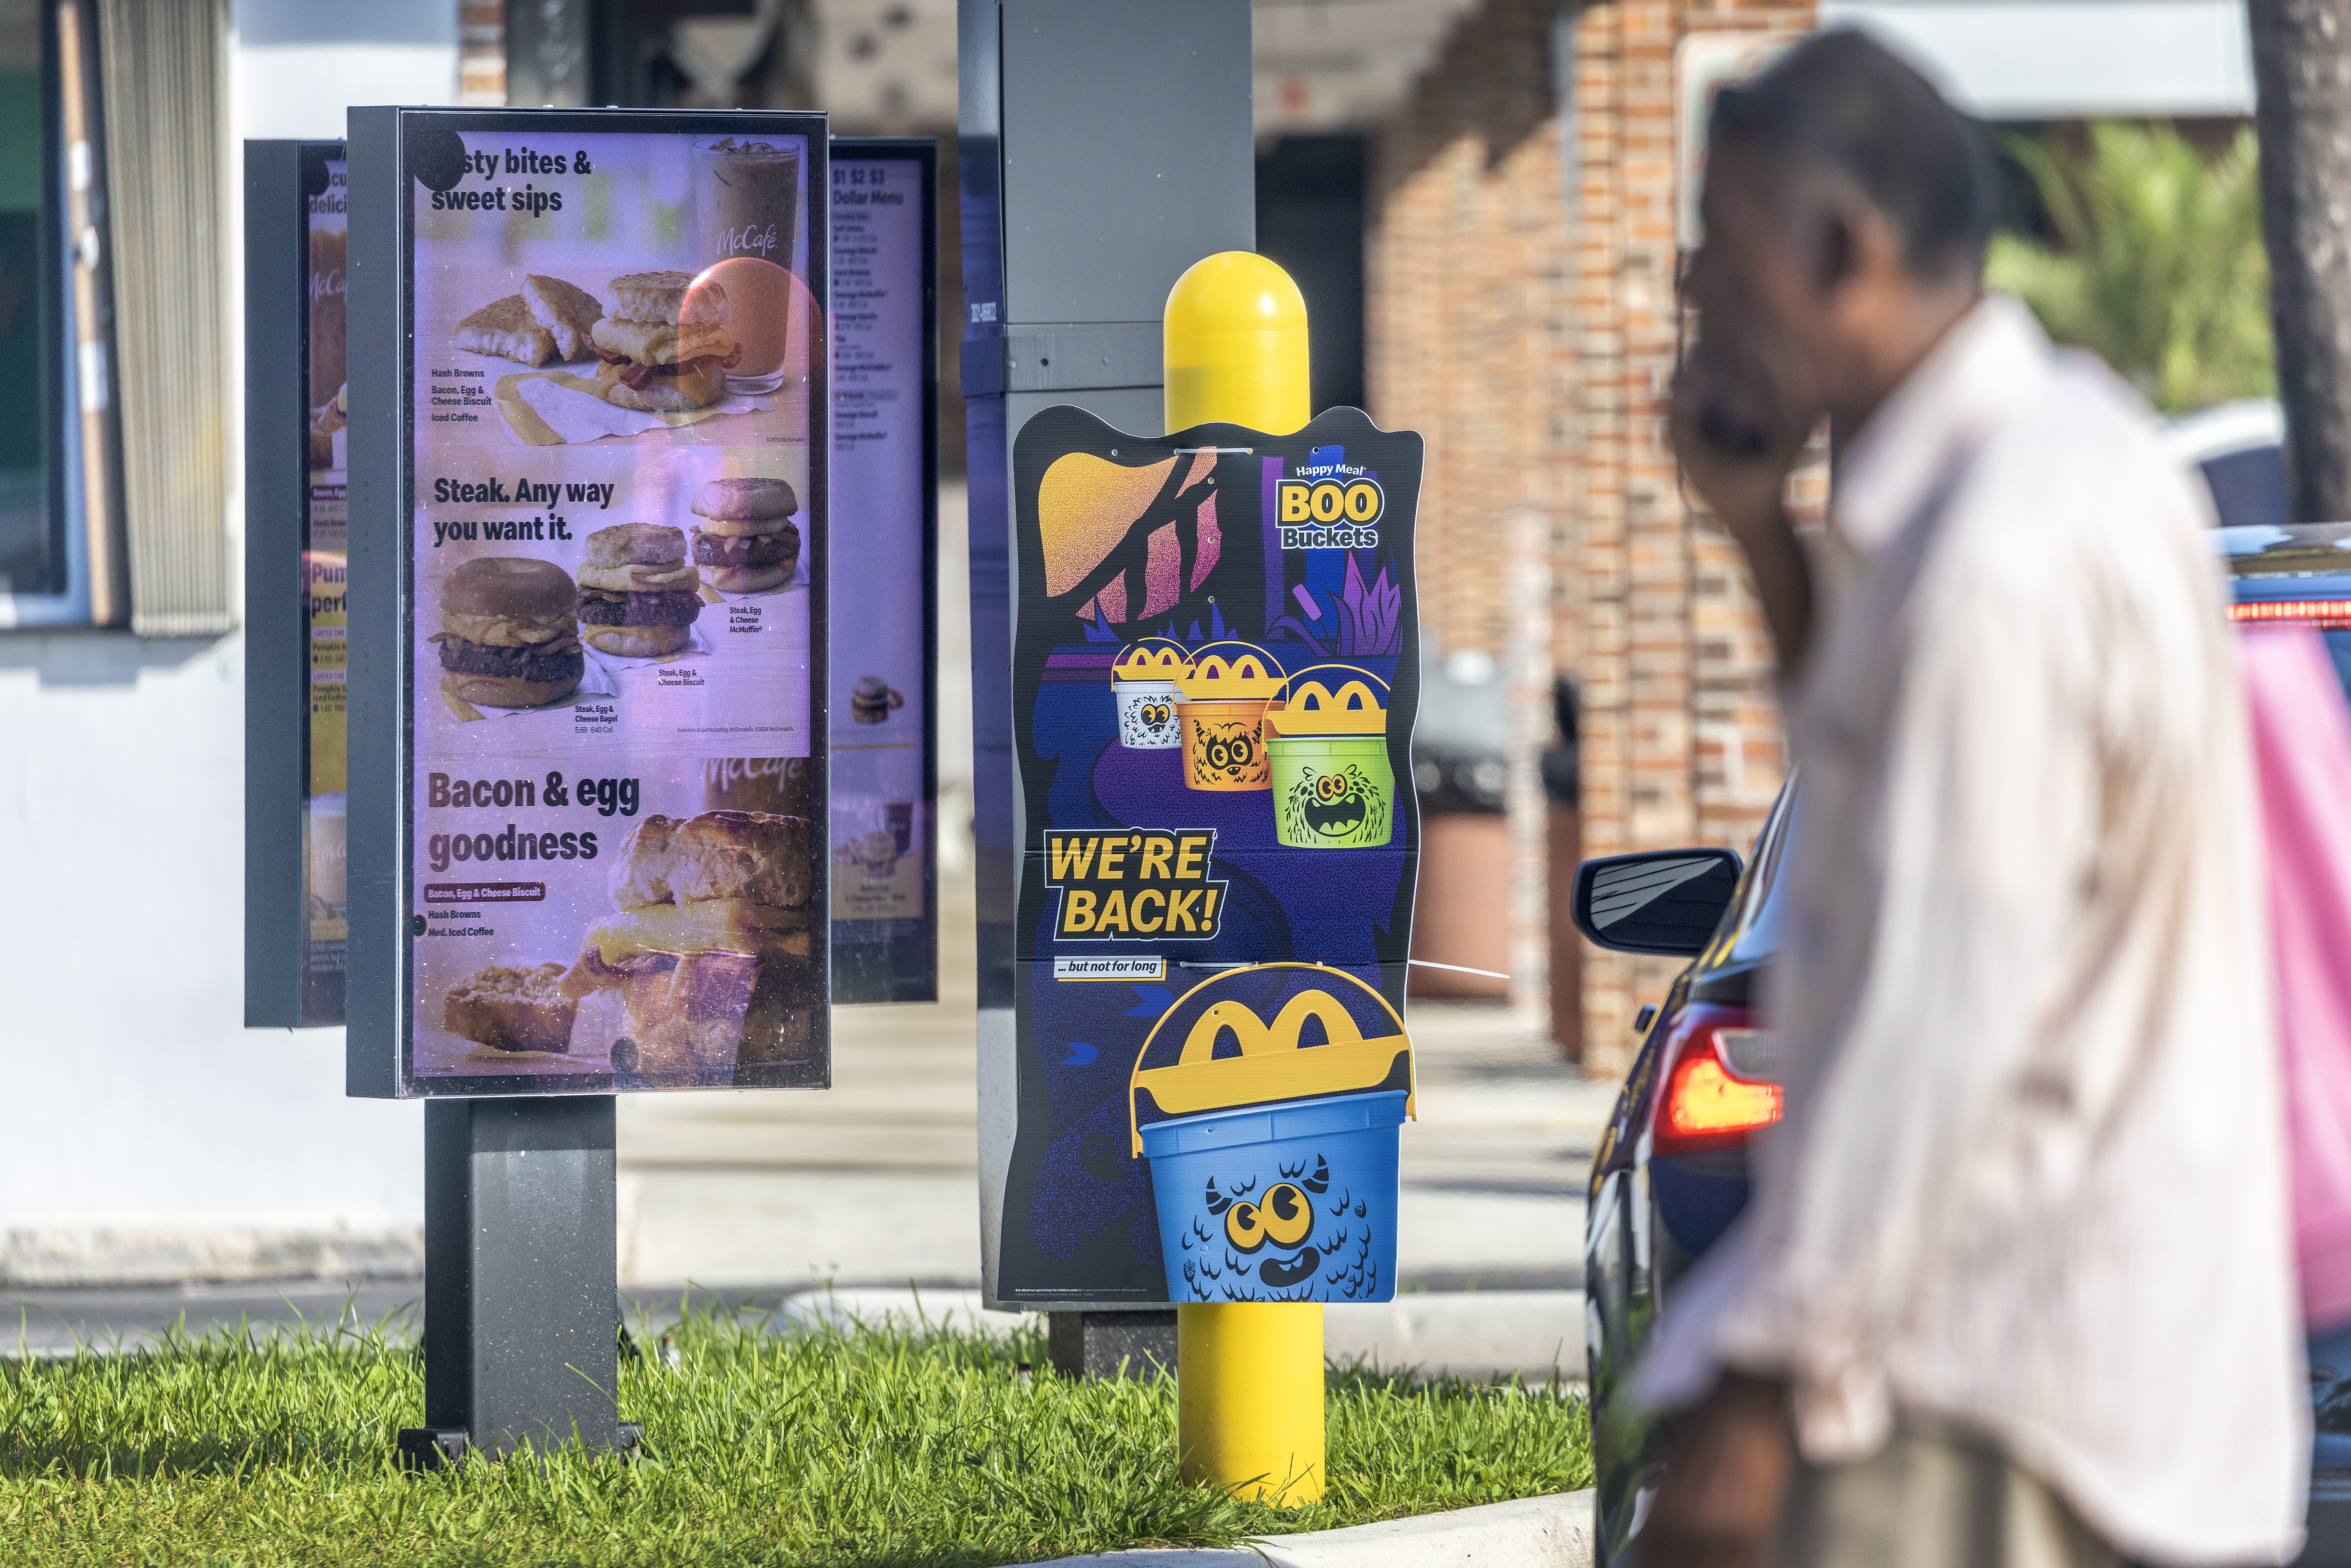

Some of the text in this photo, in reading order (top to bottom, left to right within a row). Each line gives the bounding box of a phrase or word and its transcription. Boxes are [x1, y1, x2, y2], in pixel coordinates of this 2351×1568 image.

[463, 146, 592, 181] sty bites &
[850, 168, 865, 184] $2
[870, 168, 885, 184] $3
[309, 194, 347, 213] delici
[432, 183, 562, 218] sweet sips
[833, 190, 904, 205] Dollar Menu
[717, 224, 776, 257] McCafé
[461, 386, 476, 396] Egg
[478, 386, 484, 394] &
[464, 396, 492, 405] Biscuit
[432, 413, 478, 421] Iced Coffee
[1296, 465, 1334, 477] Happy
[434, 477, 615, 510] Steak. Any way
[1282, 484, 1379, 522] BOO
[434, 513, 572, 548] you want it.
[1282, 528, 1378, 548] Buckets
[730, 606, 761, 615] Steak, Egg
[679, 669, 691, 678] Egg
[596, 705, 607, 714] Egg
[600, 715, 617, 724] Bagel
[429, 771, 639, 817] Bacon & egg
[429, 824, 598, 873] goodness
[1051, 835, 1207, 880] WE'RE
[428, 887, 541, 899] Bacon, Egg & Cheese Biscuit
[428, 910, 481, 919] Hash Browns
[1063, 889, 1218, 932] BACK!
[428, 927, 494, 937] Med. Iced Coffee
[1068, 961, 1089, 972] but
[1090, 961, 1110, 971] not
[1112, 961, 1129, 971] for
[1131, 961, 1157, 974] long
